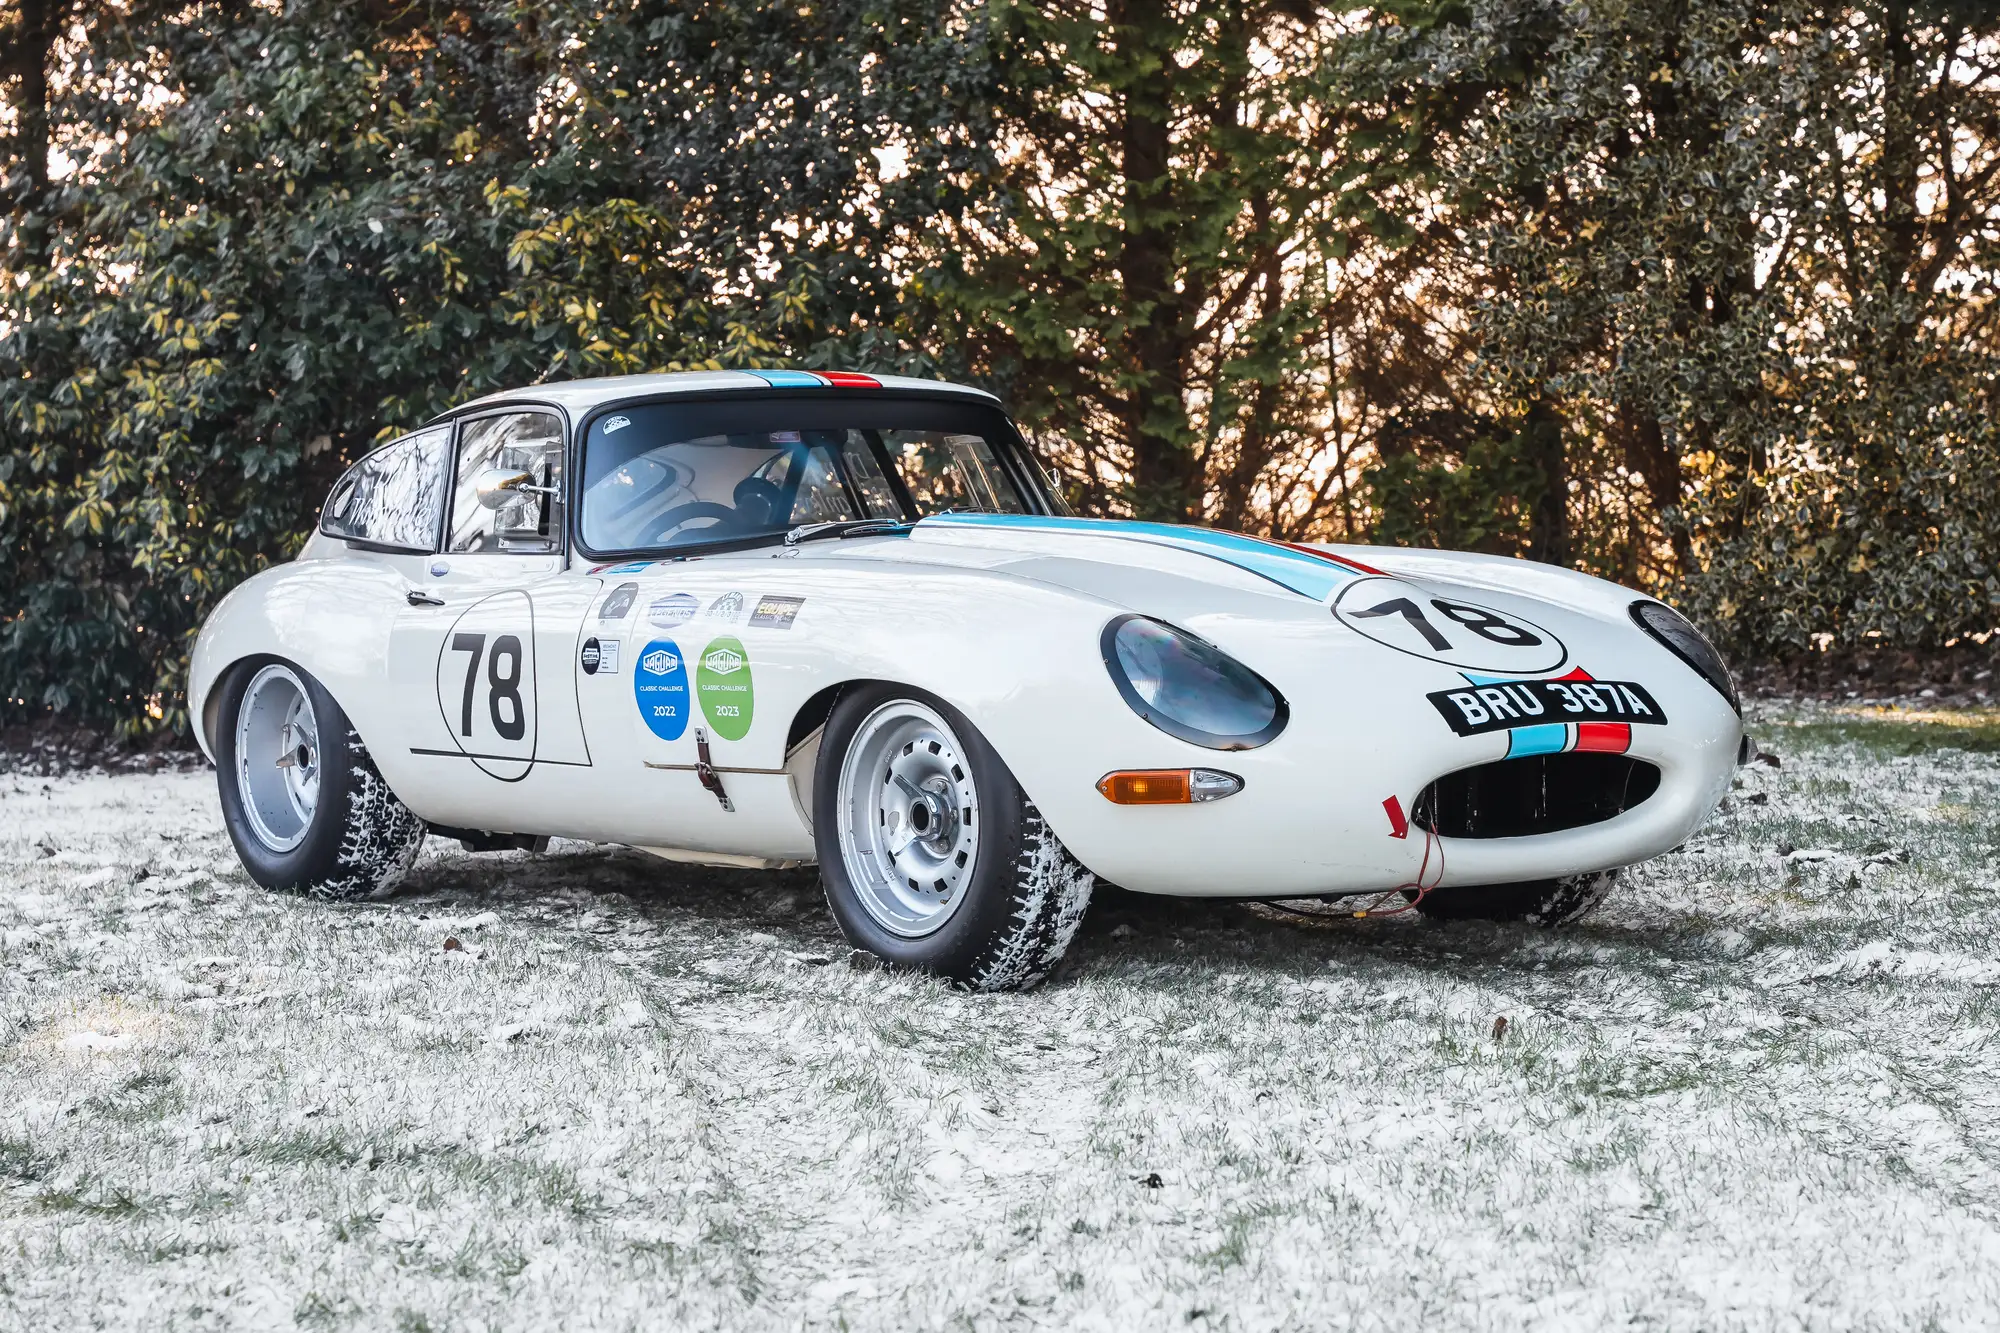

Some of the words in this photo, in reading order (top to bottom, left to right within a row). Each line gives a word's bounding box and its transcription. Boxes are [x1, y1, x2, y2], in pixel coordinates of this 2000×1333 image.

[757, 602, 798, 616] EQUIPE
[1346, 597, 1542, 652] 78
[645, 652, 676, 672] JAGUAR
[707, 652, 740, 673] JAGUAR
[451, 633, 525, 741] 78
[653, 705, 676, 717] 2022
[715, 705, 740, 717] 2023
[1447, 684, 1544, 726] BRU
[1546, 683, 1653, 716] 387A
